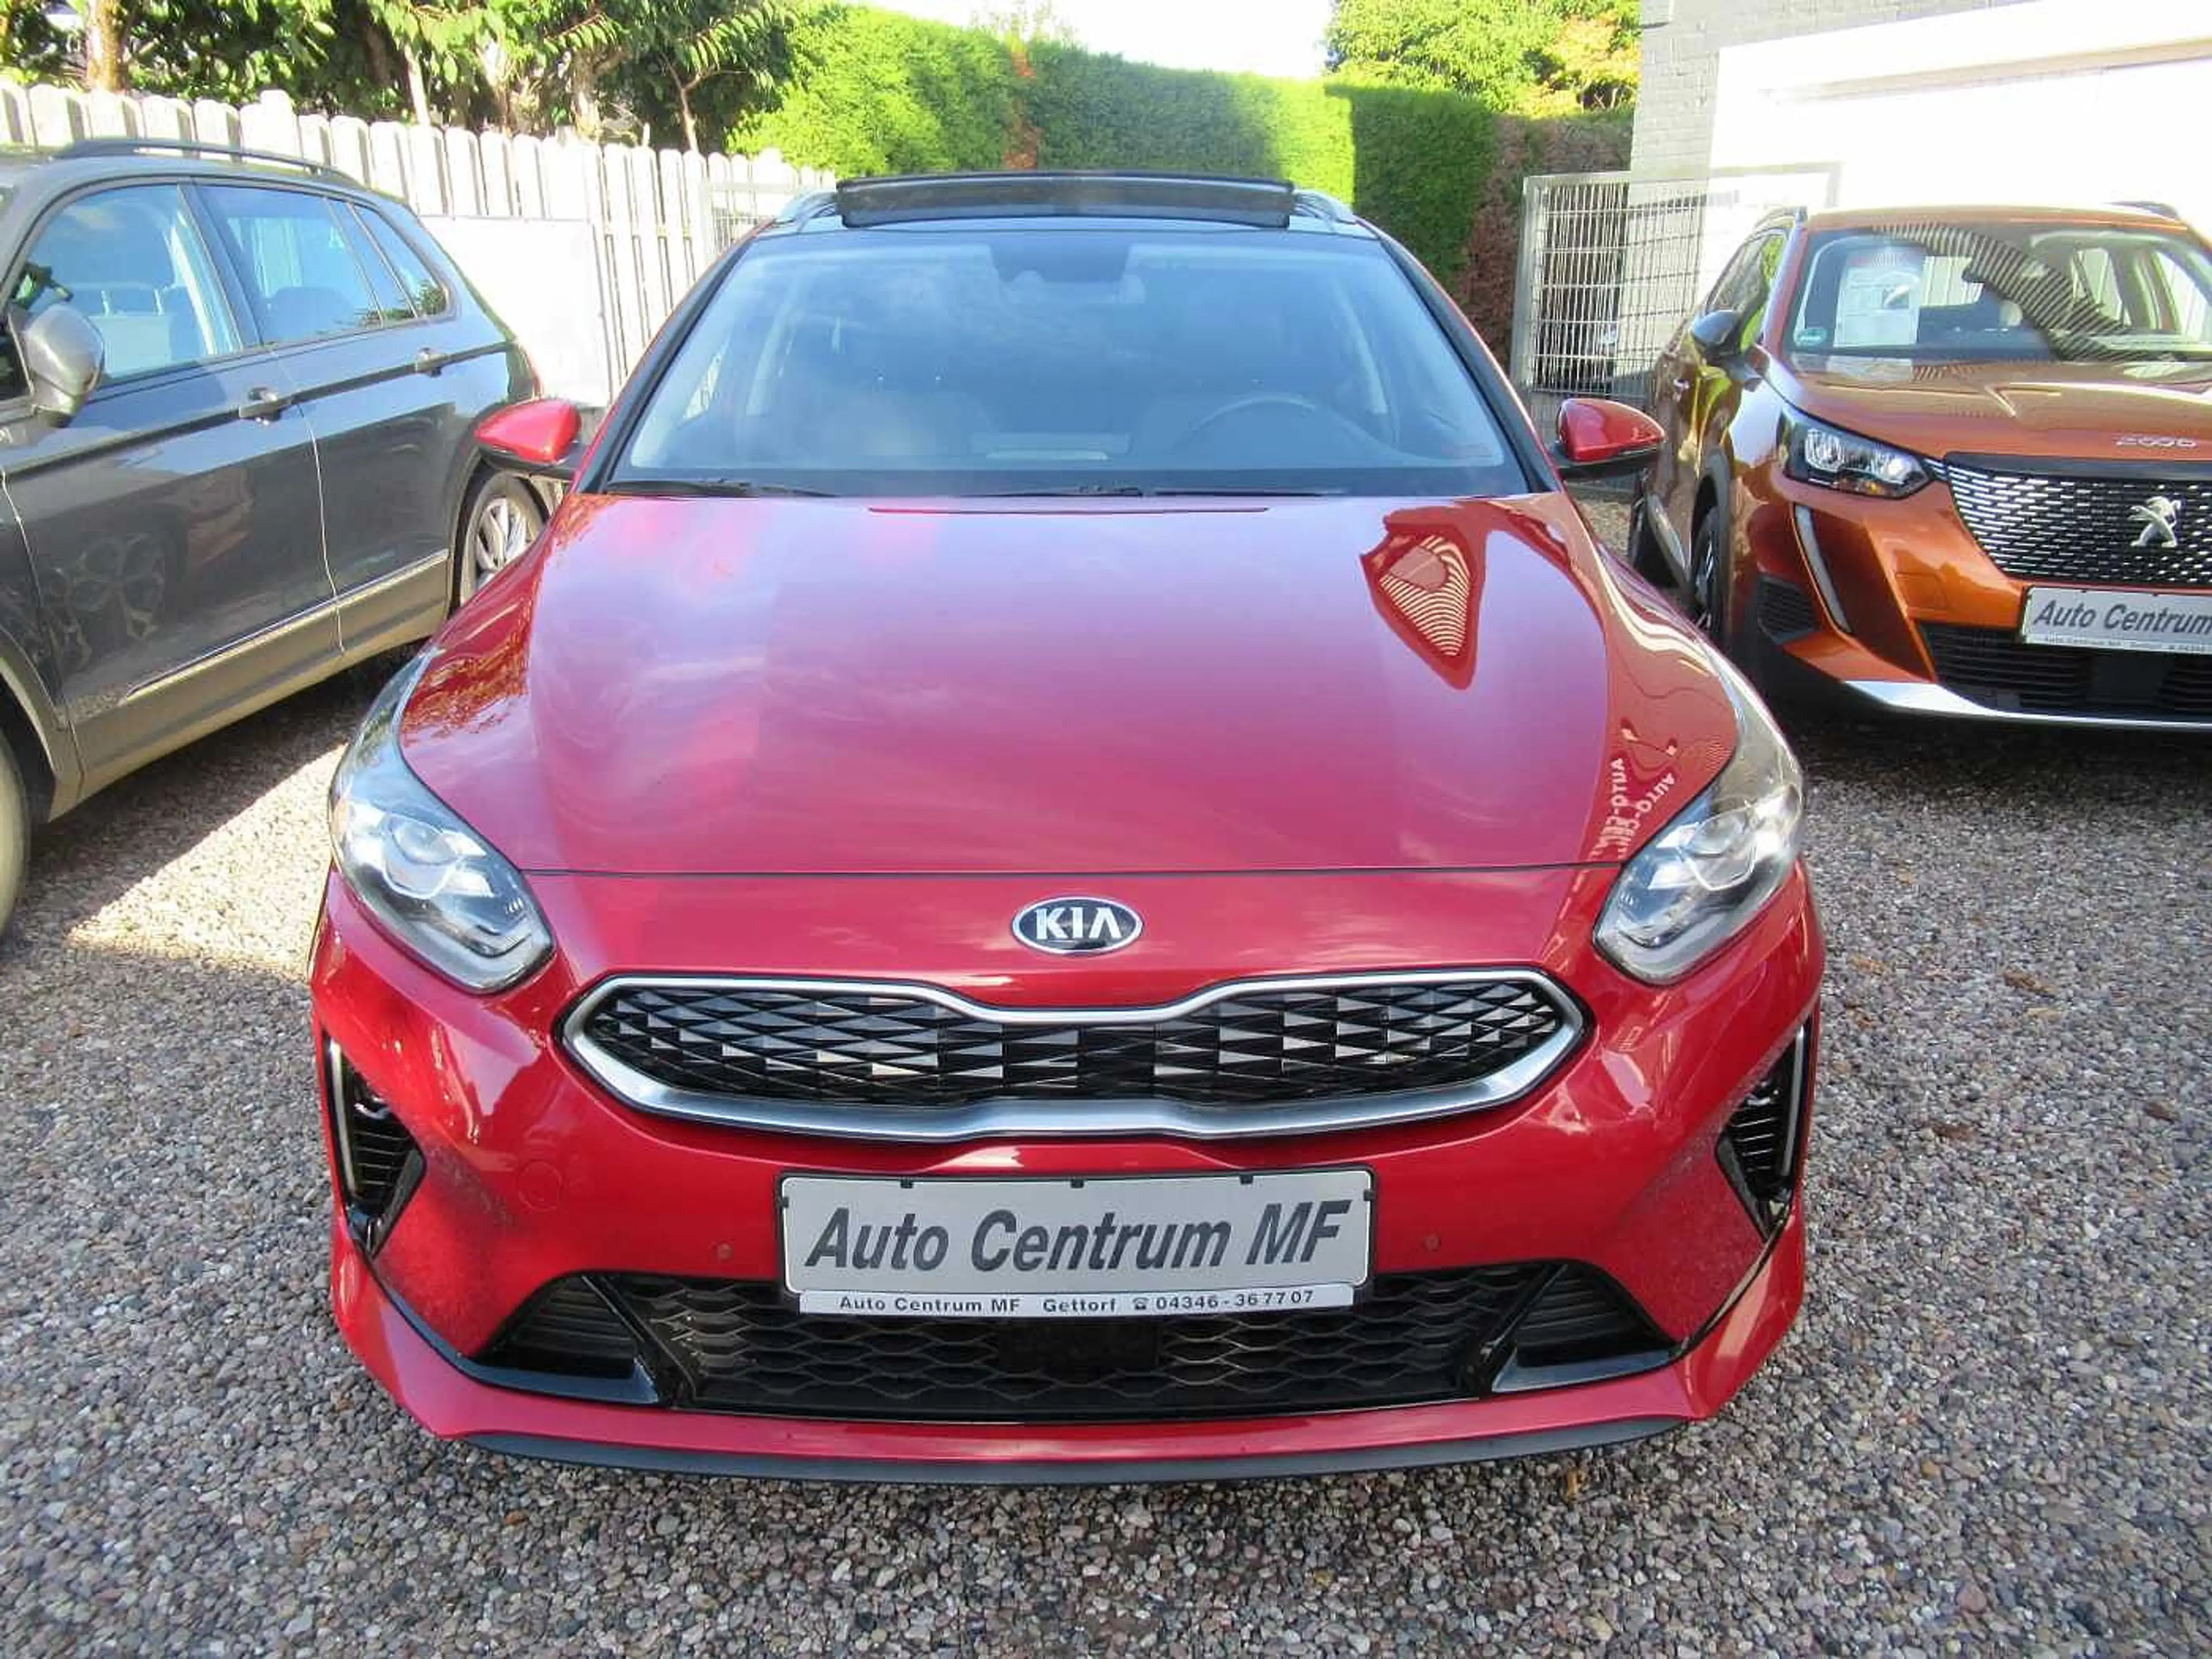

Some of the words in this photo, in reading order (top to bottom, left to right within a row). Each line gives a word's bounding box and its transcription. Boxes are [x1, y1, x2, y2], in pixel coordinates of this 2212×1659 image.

[2033, 600, 2096, 628] Auto
[1034, 907, 1122, 940] KIA
[805, 1207, 949, 1271] Auto
[971, 1209, 1232, 1272] Centrum
[1245, 1199, 1353, 1265] MF
[839, 1297, 886, 1311] Auto
[894, 1297, 983, 1313] Centrum
[991, 1298, 1022, 1313] MF
[1042, 1297, 1116, 1313] Gettorf
